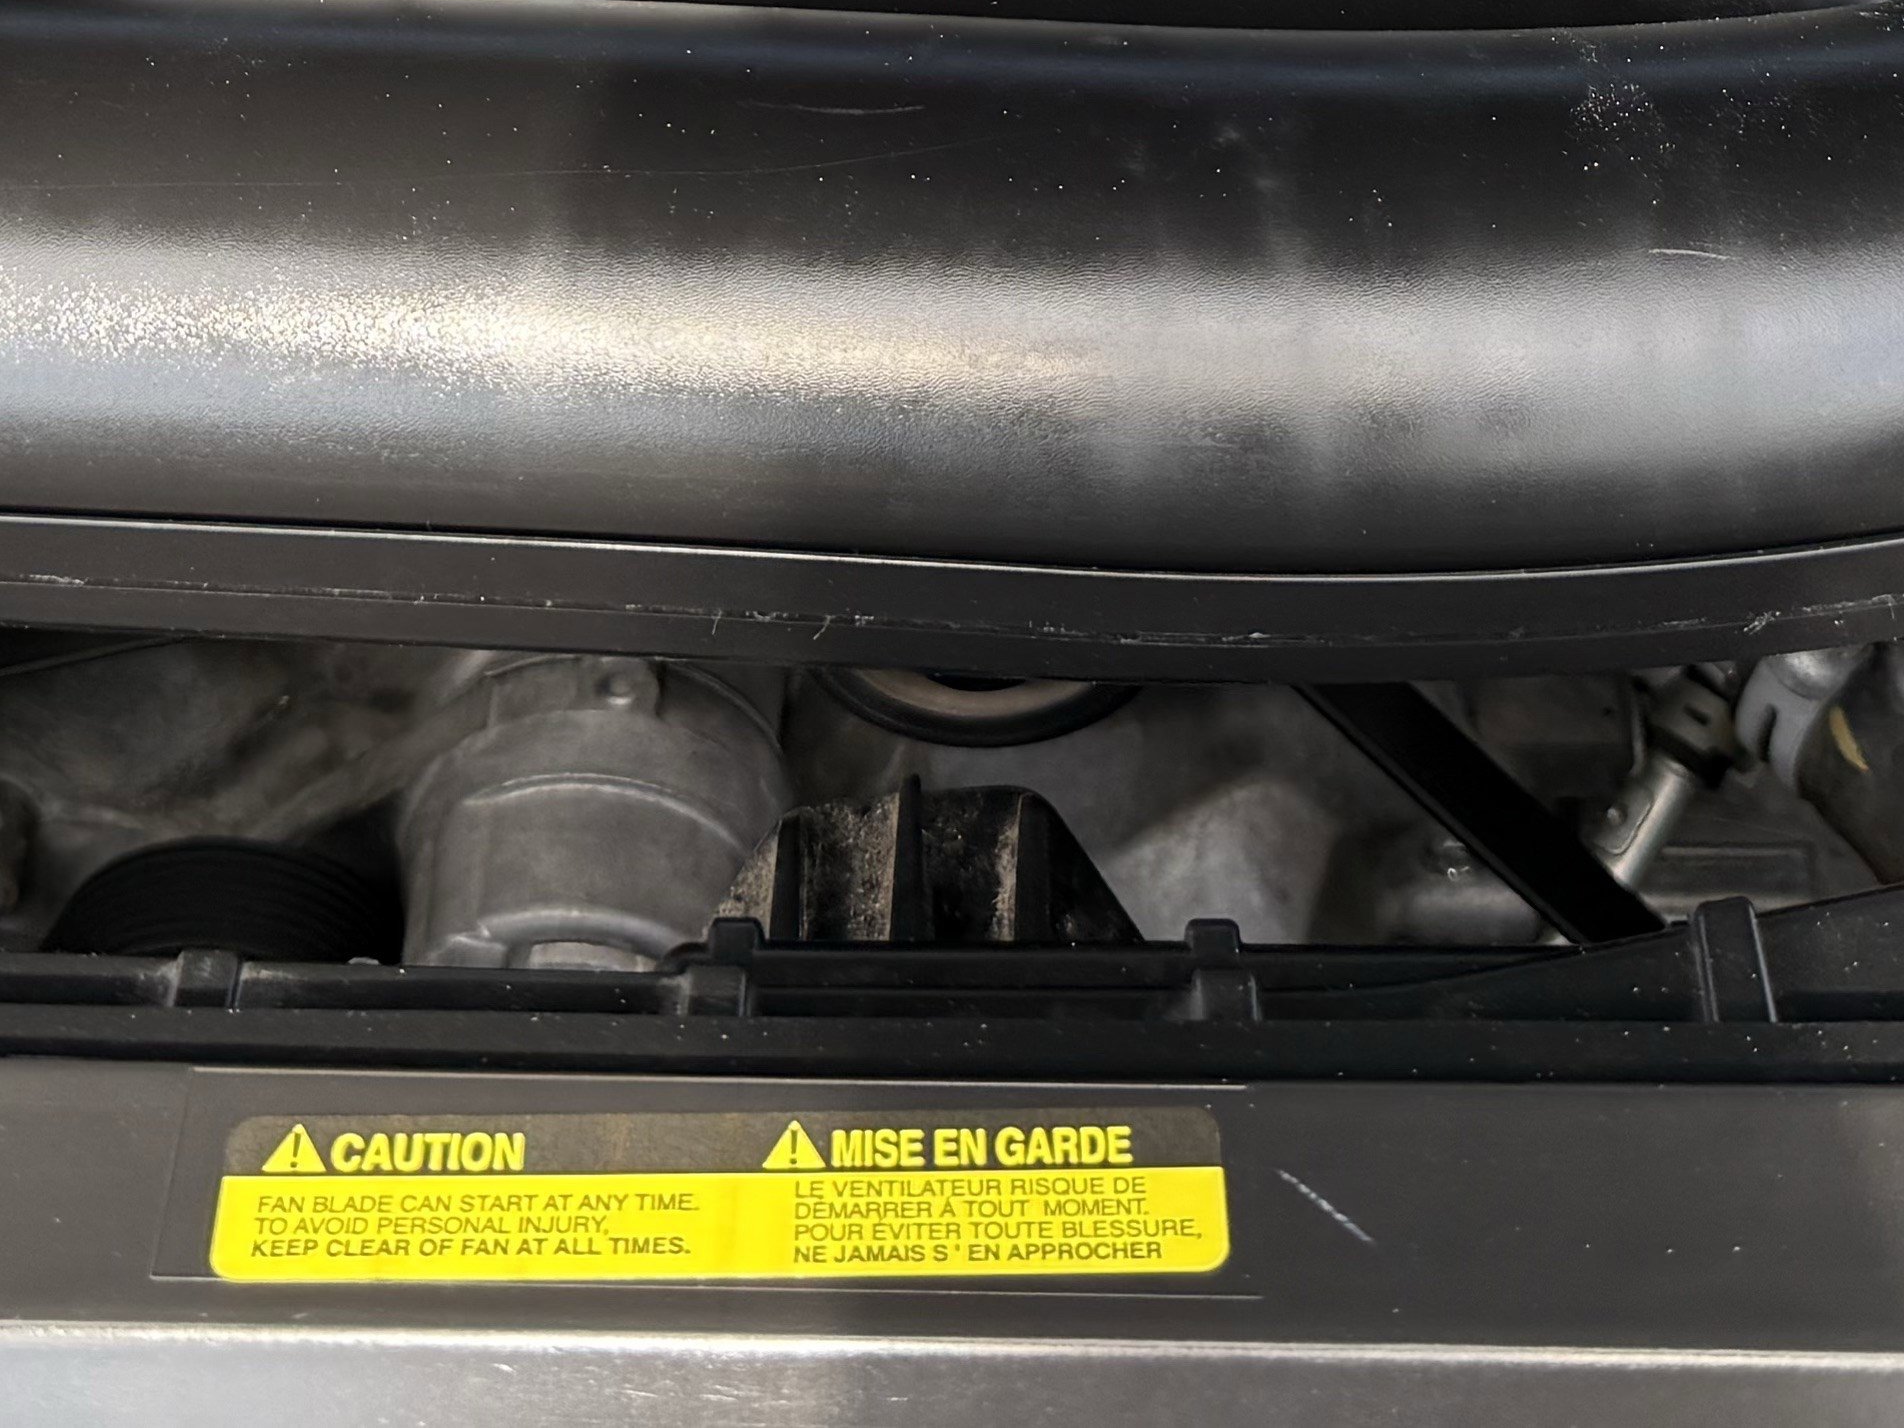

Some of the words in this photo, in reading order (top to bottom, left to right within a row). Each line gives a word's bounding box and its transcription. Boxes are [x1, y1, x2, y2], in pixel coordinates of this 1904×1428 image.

[330, 1132, 525, 1172] CAUTION
[831, 1128, 925, 1167] MISE
[934, 1128, 987, 1167] EN
[996, 1126, 1133, 1166] GARDE
[794, 1181, 823, 1198] LE
[833, 1179, 1002, 1198] VENTILATEUR
[1010, 1178, 1104, 1196] RISQUE
[1113, 1177, 1146, 1194] DE
[258, 1196, 305, 1213] FAN
[312, 1195, 394, 1213] BLADE
[400, 1195, 452, 1213] CAN
[459, 1194, 539, 1212] START
[543, 1194, 574, 1212] AT
[578, 1194, 629, 1211] ANY
[794, 1198, 932, 1220] DÉMARRER
[965, 1200, 1028, 1217] TOUT
[1044, 1198, 1149, 1217] MOMENT.
[257, 1217, 287, 1235] TO
[293, 1217, 368, 1235] AVOID
[377, 1216, 511, 1235] PERSONAL
[794, 1223, 863, 1242] POUR
[873, 1218, 961, 1241] ÉVITER
[969, 1222, 1052, 1240] TOUTE
[1063, 1219, 1202, 1240] BLESSURE,
[251, 1239, 318, 1257] KEEP
[326, 1239, 410, 1256] CLEAR
[419, 1238, 452, 1256] OF
[460, 1238, 509, 1255] FAN
[516, 1238, 548, 1255] AT
[553, 1237, 601, 1255] ALL
[609, 1237, 691, 1254] TIMES.
[794, 1245, 827, 1263] NE
[834, 1244, 925, 1263] JAMAIS
[968, 1243, 1000, 1261] EN
[1007, 1241, 1162, 1261] APPROCHER
